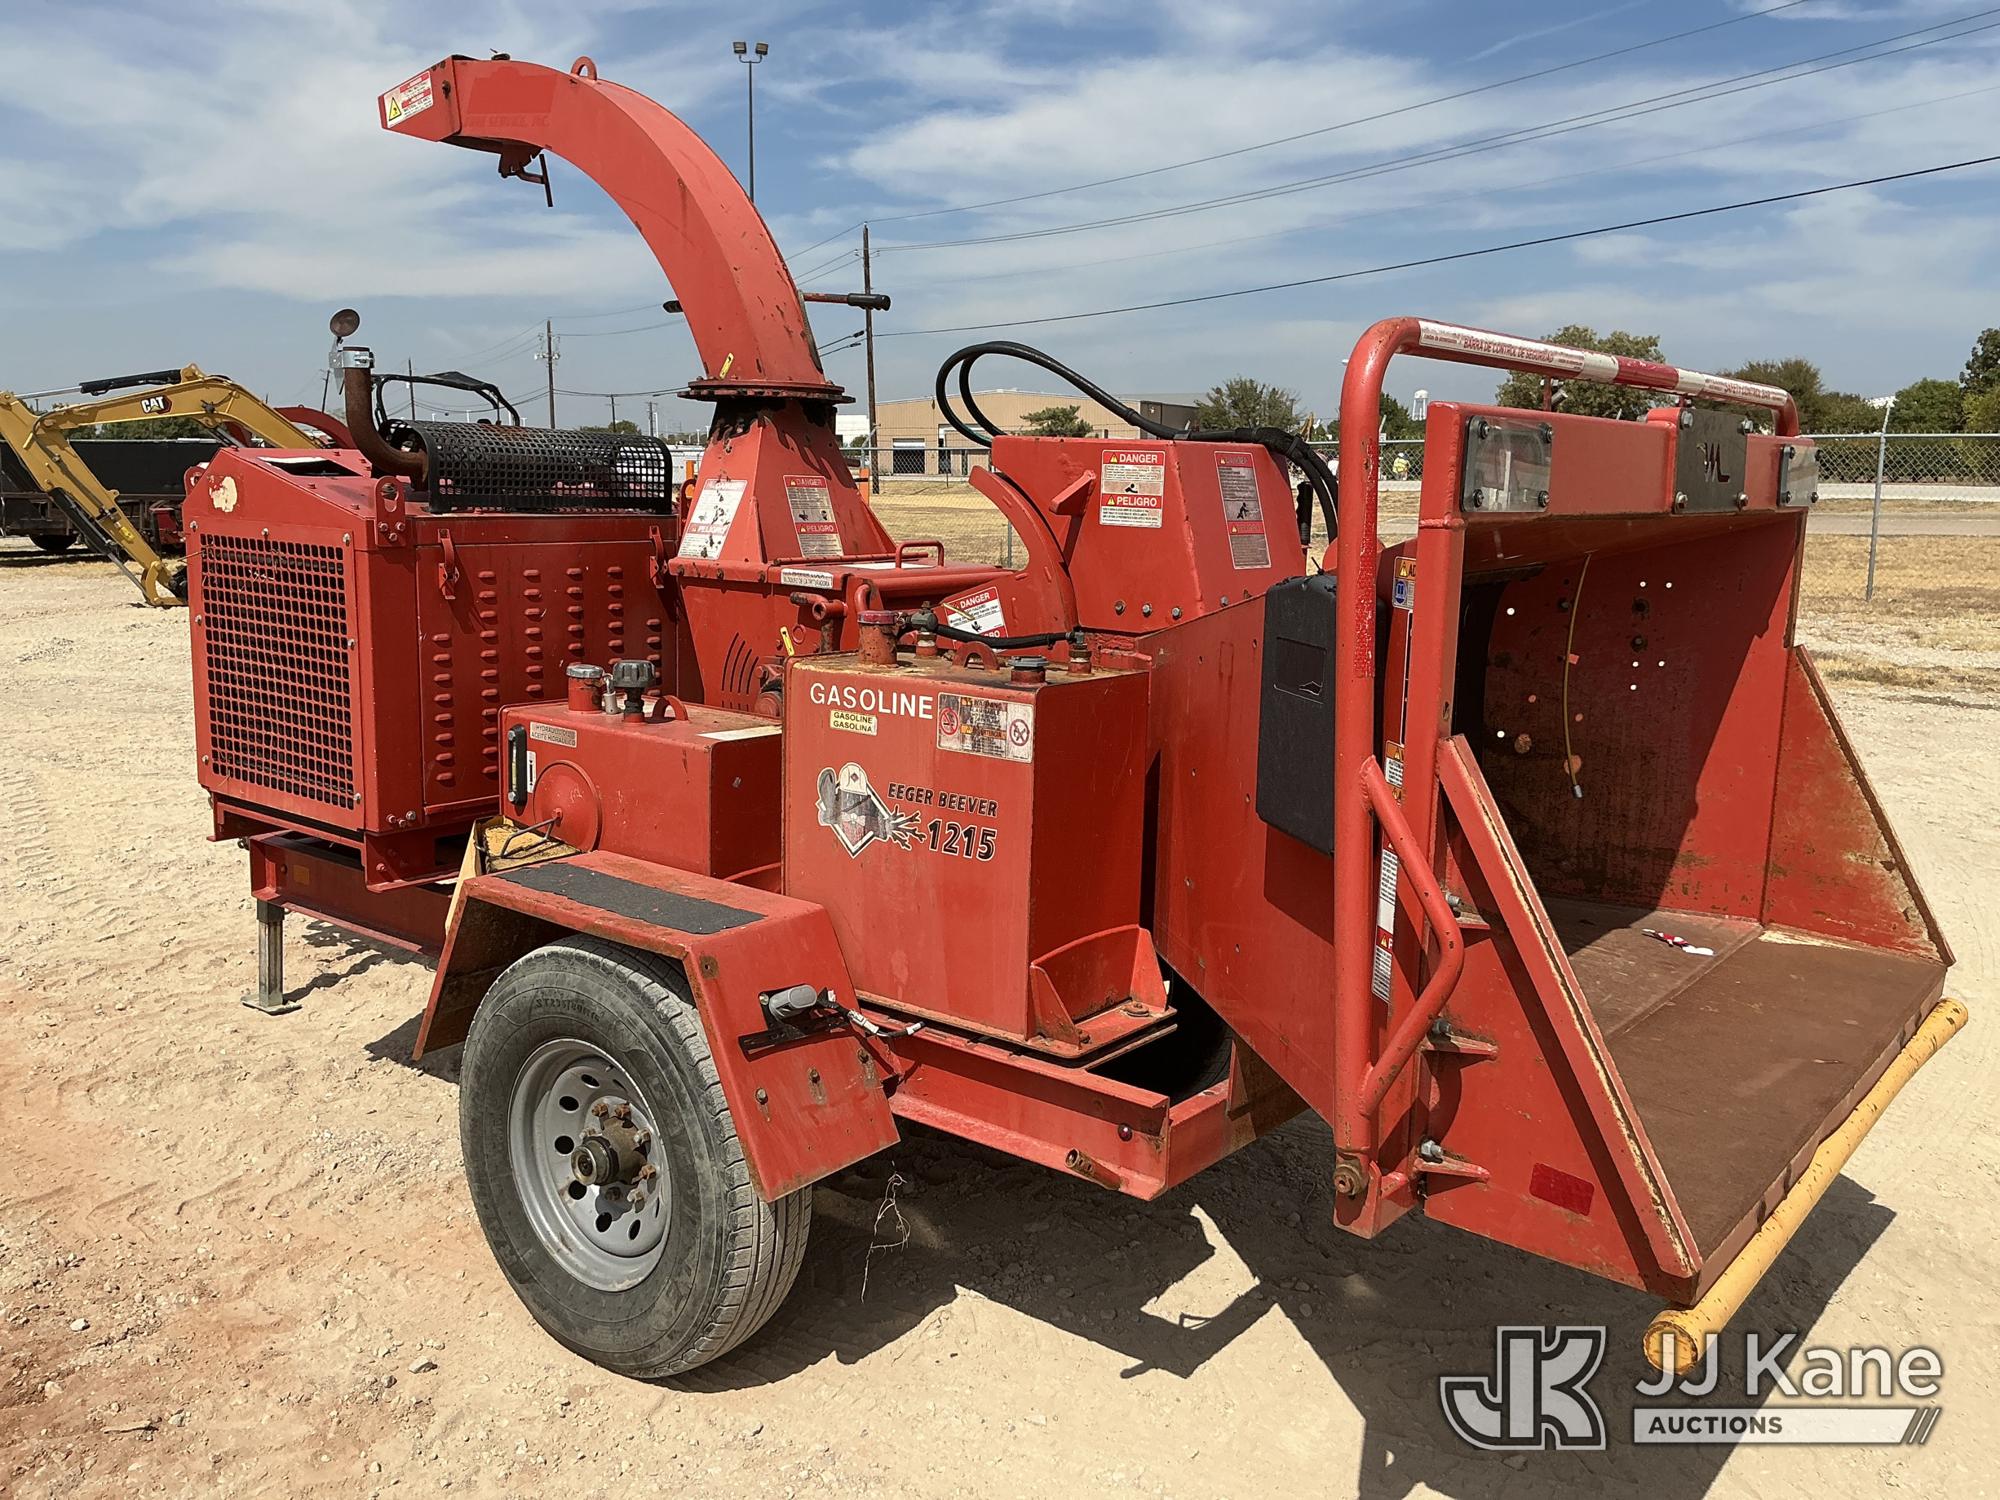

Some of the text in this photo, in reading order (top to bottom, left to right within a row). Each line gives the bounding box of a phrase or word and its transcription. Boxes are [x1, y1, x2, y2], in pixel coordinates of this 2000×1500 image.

[141, 396, 165, 413] CAT
[1119, 454, 1158, 463] DANGER
[796, 478, 823, 486] DANGER
[1116, 496, 1157, 507] PELIGRO
[806, 524, 834, 532] PELIGRO
[960, 592, 990, 609] DANGER
[810, 682, 933, 720] GASOLINE
[833, 711, 873, 724] GASOLINE
[833, 720, 873, 733] GASOLINA
[888, 783, 998, 817] EEGER BEEVER
[928, 818, 998, 862] 1215
